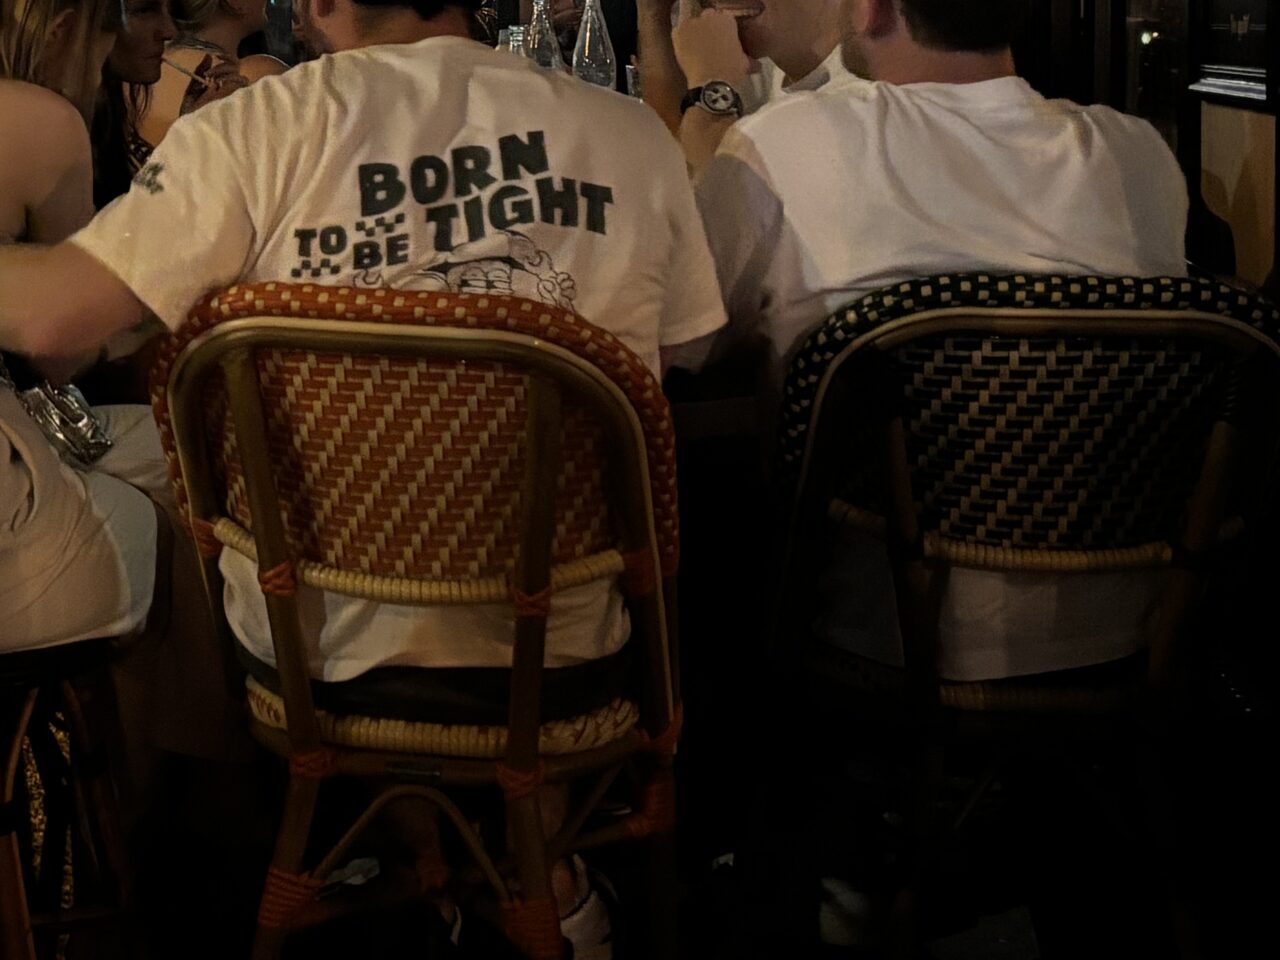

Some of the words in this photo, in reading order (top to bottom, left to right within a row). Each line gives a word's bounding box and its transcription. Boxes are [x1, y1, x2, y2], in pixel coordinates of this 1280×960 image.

[358, 130, 549, 217] BORN
[294, 225, 347, 258] TO
[353, 233, 410, 270] BE
[426, 176, 615, 252] TIGHT
